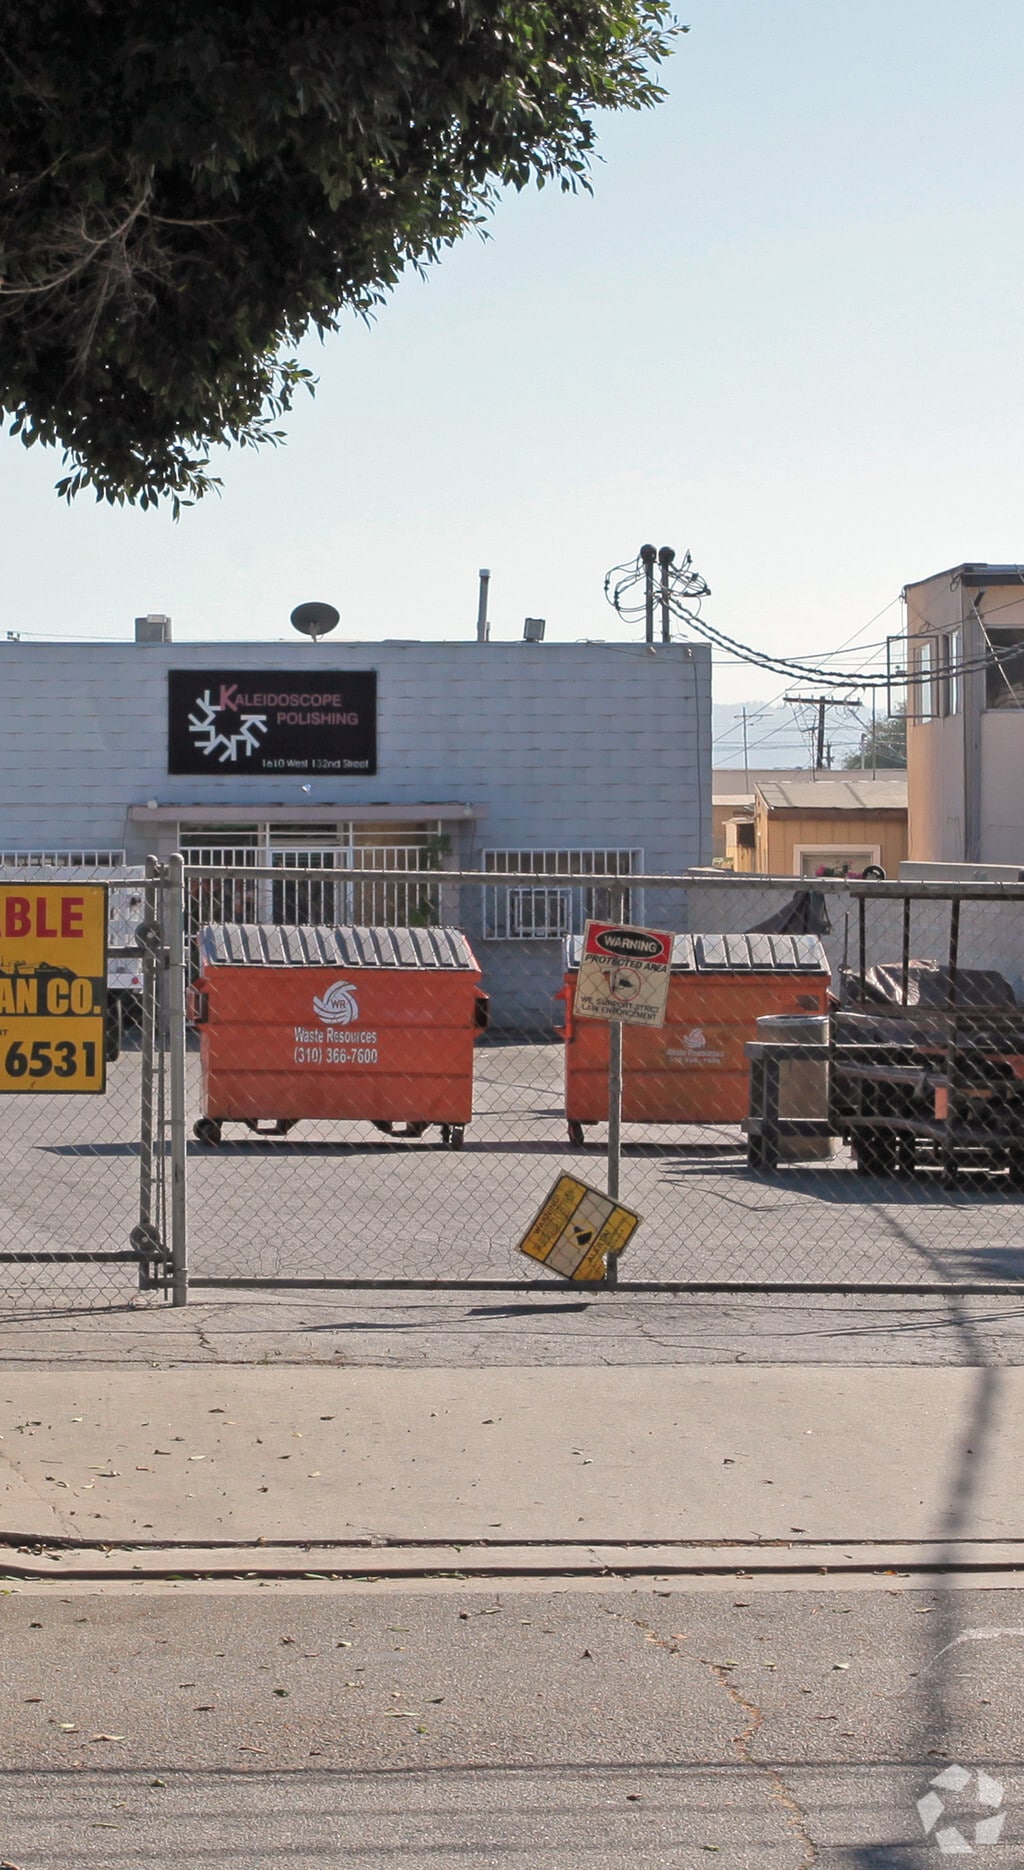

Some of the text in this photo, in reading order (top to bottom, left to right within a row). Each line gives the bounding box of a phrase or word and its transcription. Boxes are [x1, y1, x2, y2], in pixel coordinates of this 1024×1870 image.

[220, 684, 343, 711] KALEIDOSCOPE
[277, 712, 359, 726] POLISHING
[262, 759, 369, 768] 1610 West 132nd Street
[604, 935, 657, 953] WARNING
[585, 954, 667, 973] PROTECTED AREA
[46, 978, 102, 1015] CO.
[331, 999, 346, 1009] WR
[596, 998, 633, 1009] SUPPORT
[582, 1004, 657, 1020] LAW ENFORCEMENT
[294, 1027, 377, 1043] Waste Resources
[294, 1047, 378, 1064] (310) 366-7600
